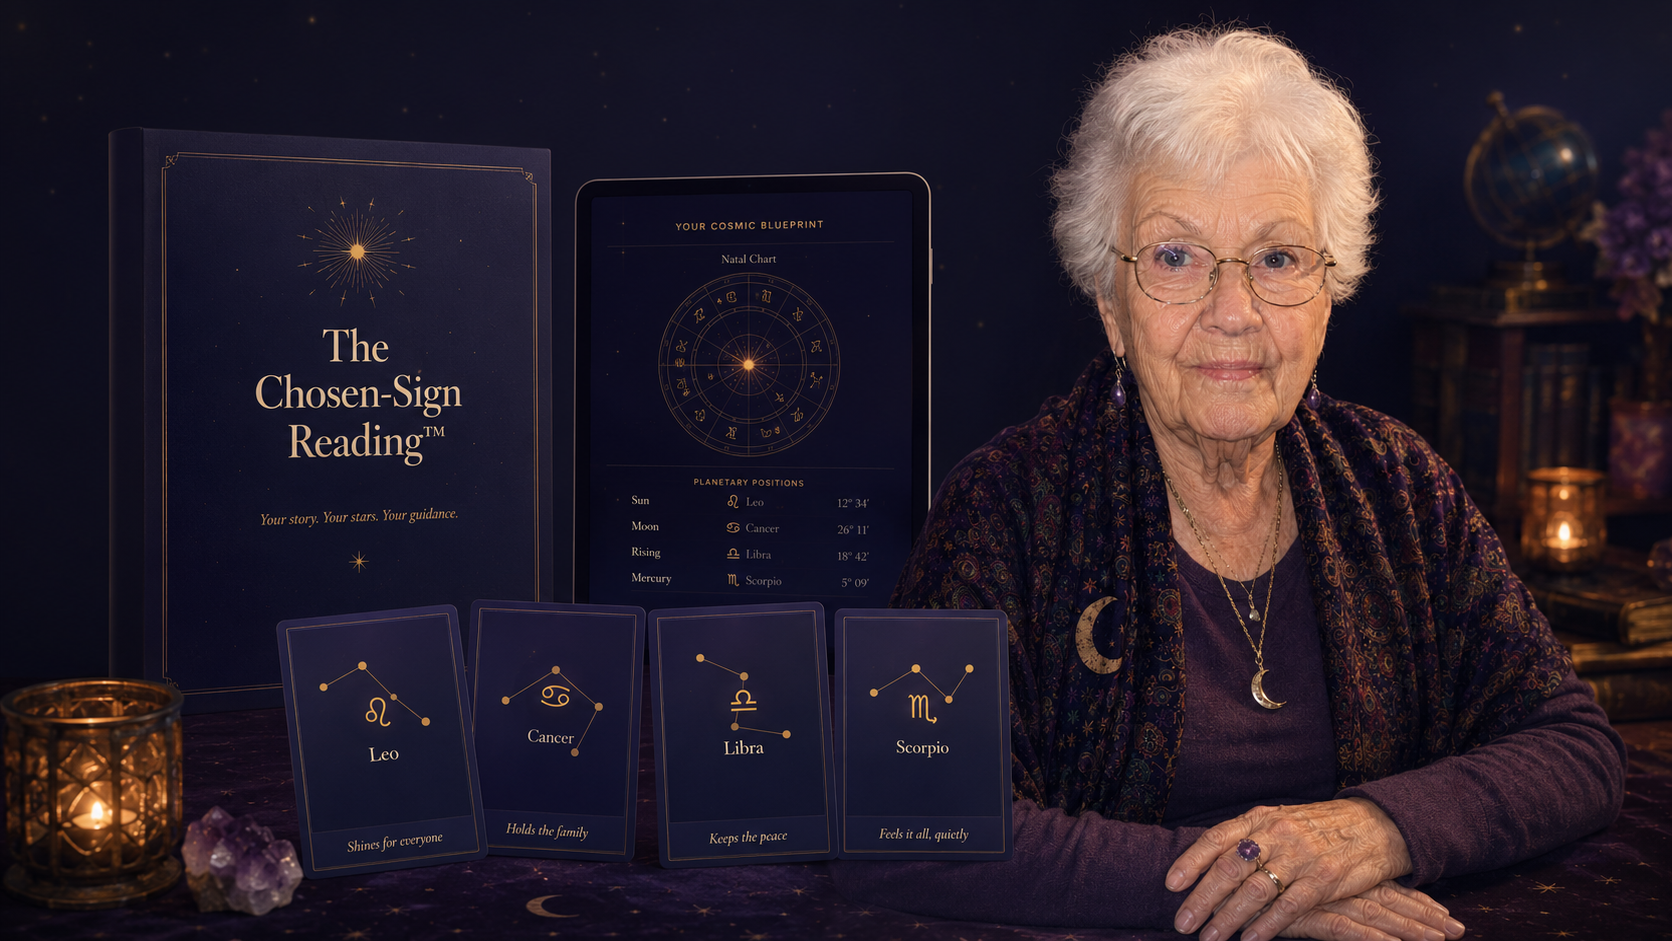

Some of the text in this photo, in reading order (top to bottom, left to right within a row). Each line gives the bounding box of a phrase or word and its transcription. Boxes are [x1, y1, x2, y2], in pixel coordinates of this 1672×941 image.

[675, 219, 824, 232] YOUR COSMIC BLUEPRINT
[721, 253, 777, 264] Natal Chart
[322, 327, 389, 363] The
[255, 373, 463, 419] Chosen-Sign
[693, 477, 805, 488] PLANETARY POSITIONS
[631, 494, 650, 505] Sun
[746, 496, 765, 507] Leo
[260, 507, 459, 529] Your story. Your stars. Your guidance.
[631, 520, 660, 532] Moon
[745, 522, 780, 534] Cancer
[631, 546, 661, 560] Rising
[746, 548, 772, 560] Libra
[631, 572, 672, 586] Mercury
[745, 574, 783, 589] Scorpio
[527, 728, 575, 745] Cancer
[368, 746, 400, 763] Leo
[723, 739, 765, 756] Libra
[896, 739, 950, 759] Scorpio
[505, 822, 589, 842] Holds the family
[709, 830, 788, 847] Keeps the peace
[879, 827, 970, 844] Feels it all, quietly
[347, 833, 443, 853] Shines for everyone
